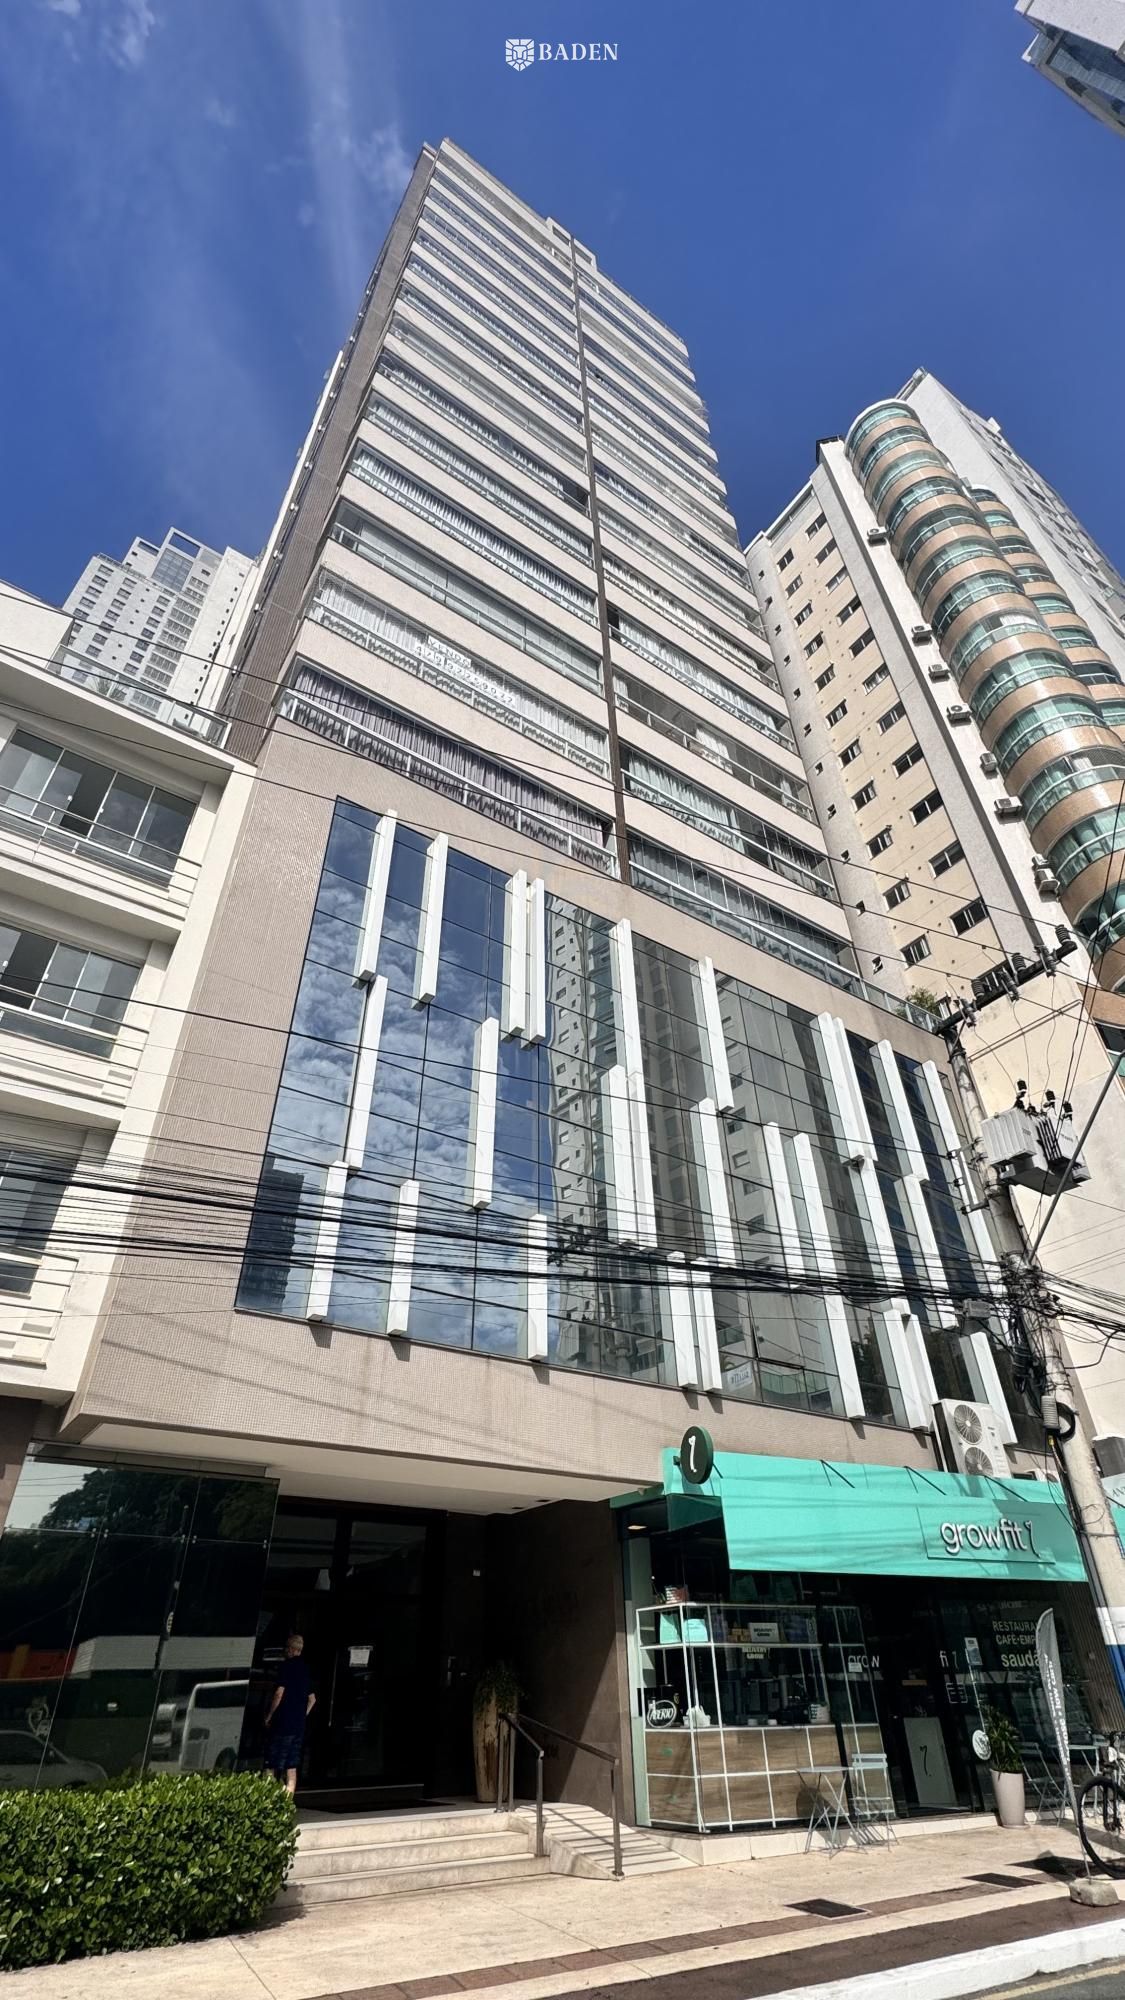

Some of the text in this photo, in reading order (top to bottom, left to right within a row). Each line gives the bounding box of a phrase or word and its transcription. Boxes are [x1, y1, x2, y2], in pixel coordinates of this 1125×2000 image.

[429, 637, 471, 667] VENDO
[941, 1519, 1027, 1555] growfit
[992, 1620, 1038, 1632] RESTAURA
[1001, 1650, 1041, 1668] saudá
